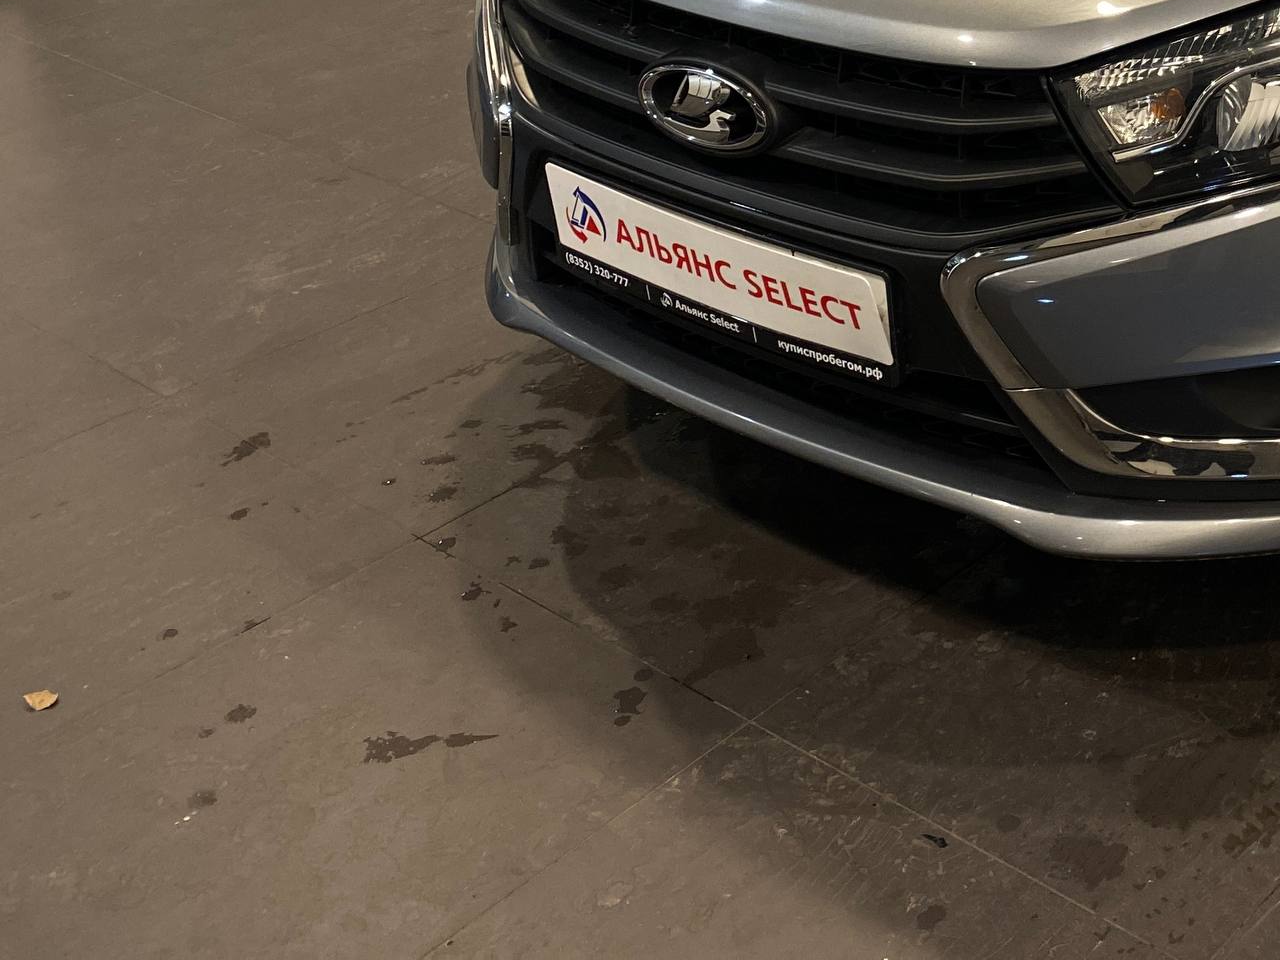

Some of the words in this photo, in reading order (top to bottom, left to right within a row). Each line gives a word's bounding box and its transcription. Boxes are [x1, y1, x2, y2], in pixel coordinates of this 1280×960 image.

[565, 251, 593, 275] (8352)
[594, 264, 629, 287] 320-777
[616, 218, 737, 290] АЛЬЯНС
[743, 269, 861, 330] SELECT
[675, 299, 709, 321] Альянс
[710, 313, 740, 333] Select
[778, 340, 883, 380] куписпробегом.рф
